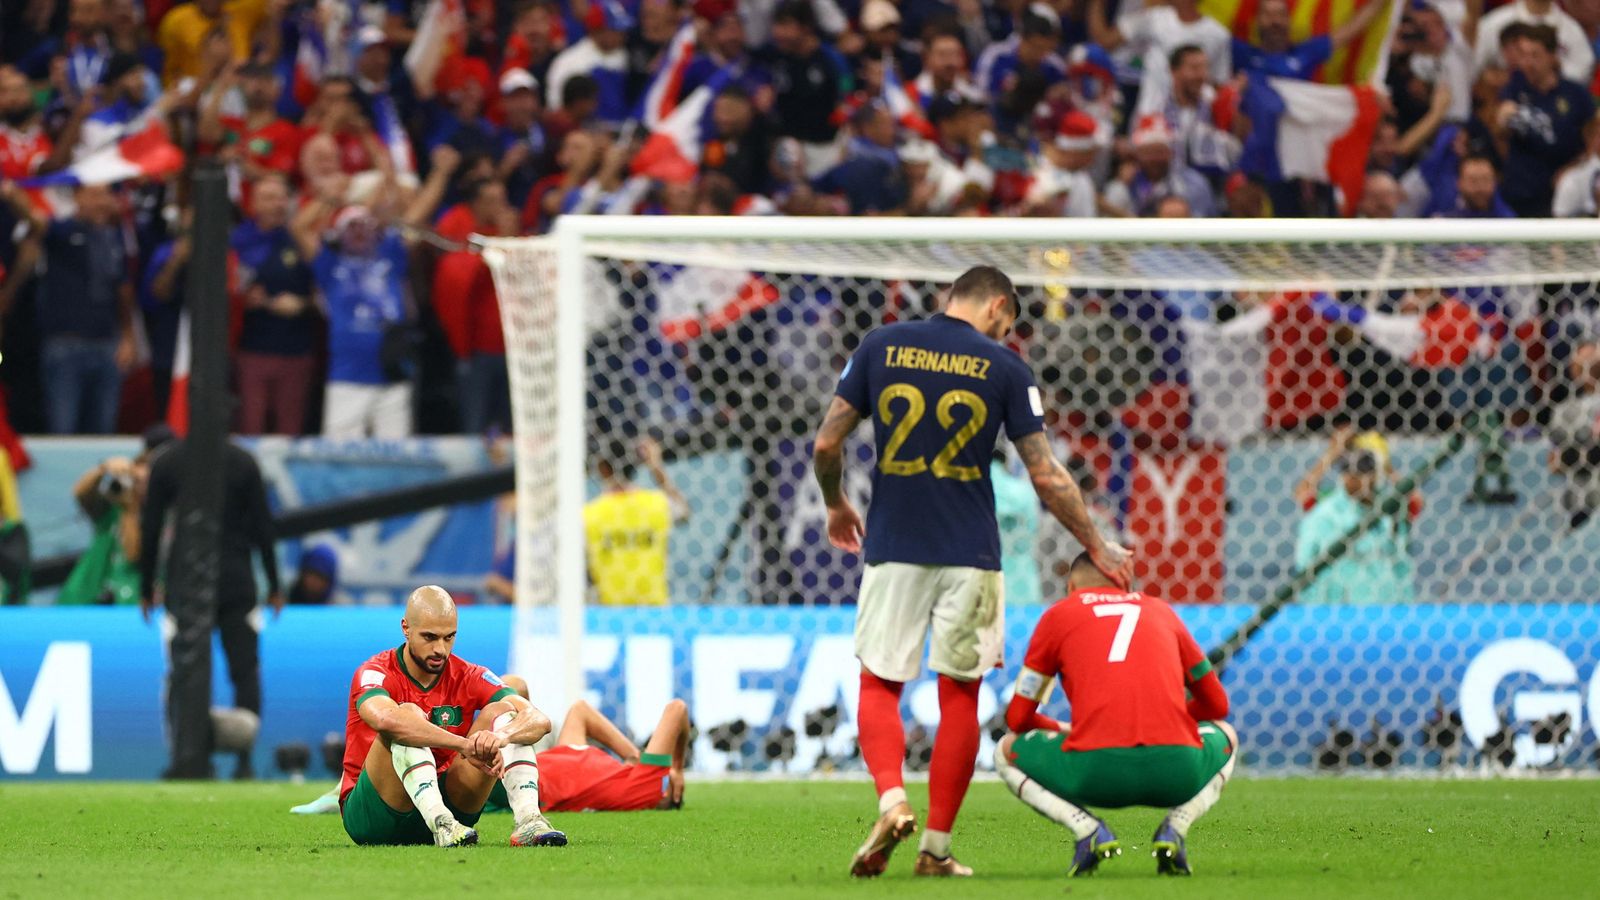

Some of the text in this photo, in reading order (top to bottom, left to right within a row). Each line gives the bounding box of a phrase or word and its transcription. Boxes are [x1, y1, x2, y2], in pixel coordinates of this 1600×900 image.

[885, 345, 992, 380] T.HERNANDEZ
[877, 382, 988, 482] 22
[1092, 602, 1142, 663] 7
[1459, 636, 1600, 769] G
